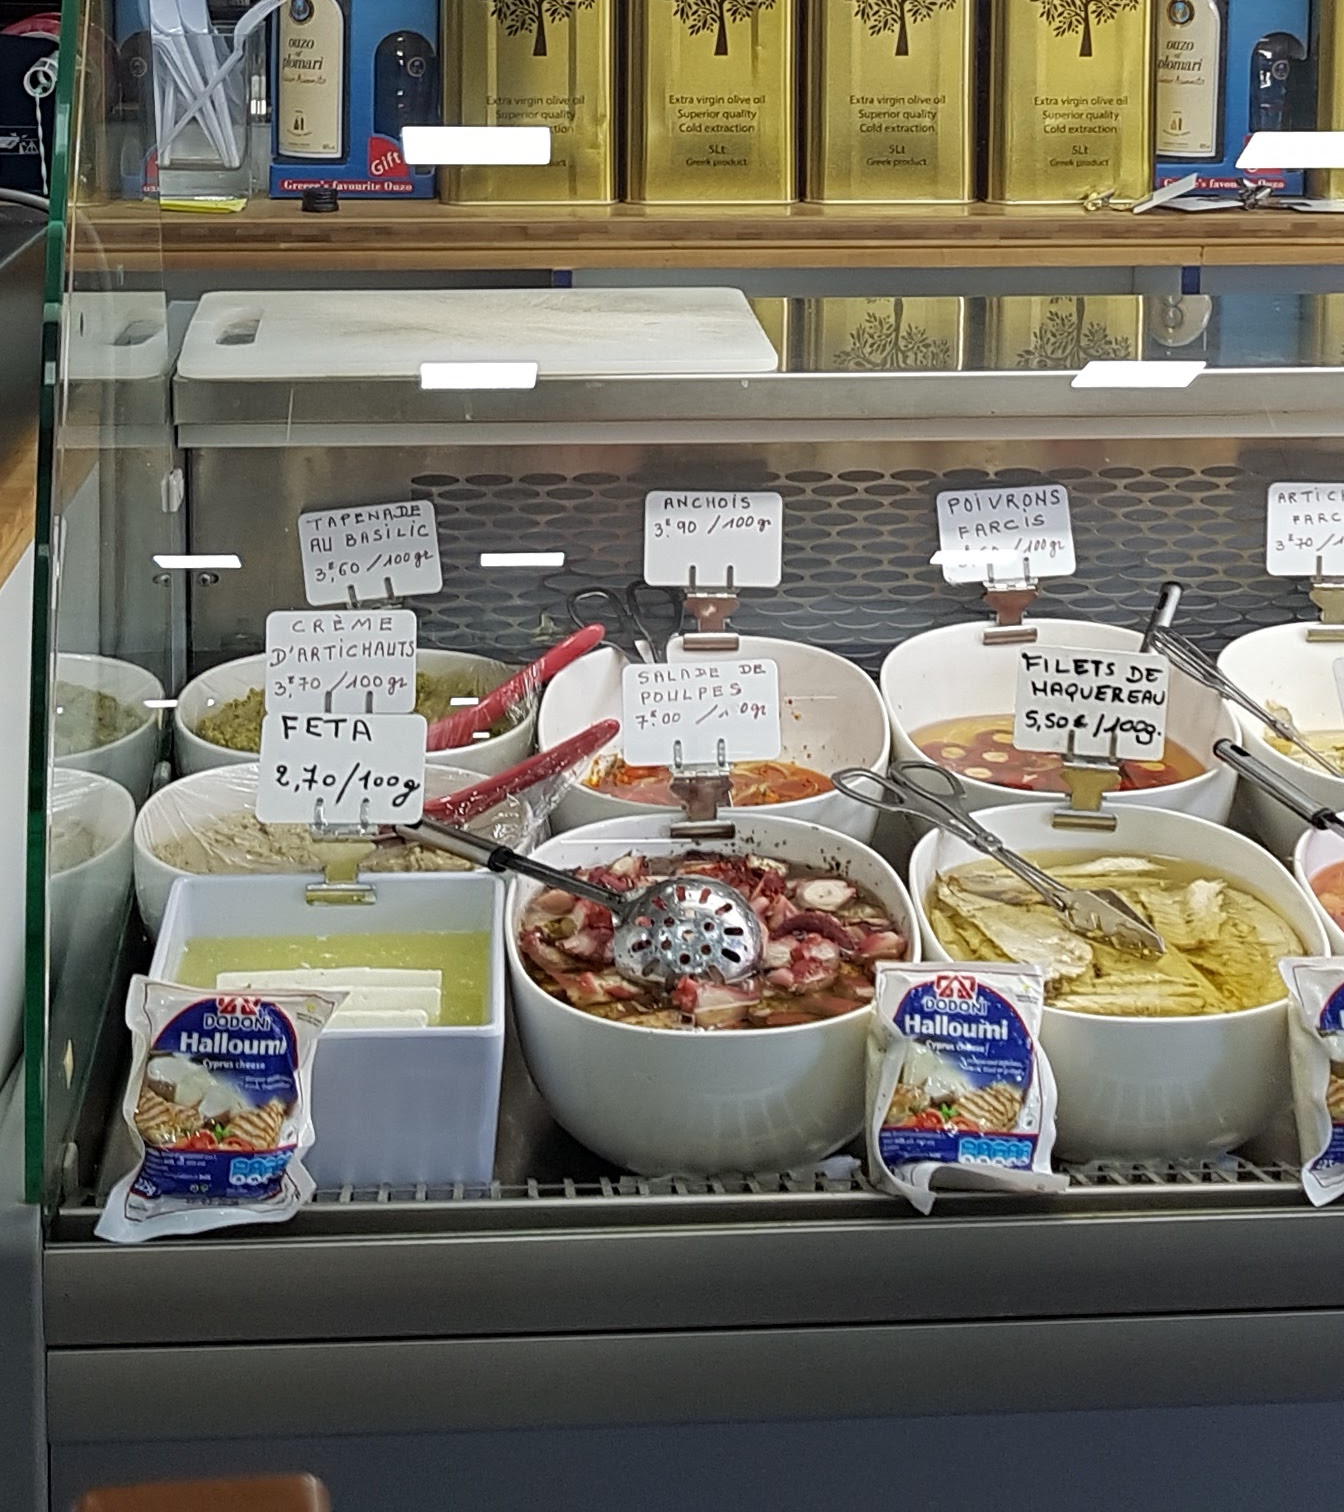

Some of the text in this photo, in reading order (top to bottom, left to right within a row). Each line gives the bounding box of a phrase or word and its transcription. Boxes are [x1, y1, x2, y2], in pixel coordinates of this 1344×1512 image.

[288, 37, 314, 50] ouzo
[1166, 40, 1194, 51] ouzo
[669, 95, 765, 108] Extra virgin olive oil
[849, 95, 946, 108] Extra virgin olive oil
[677, 109, 757, 122] Superior quality
[858, 109, 937, 122] Superior quality
[679, 123, 755, 133] Cold extraction
[860, 123, 935, 133] Cold extraction
[371, 151, 400, 175] Gift
[713, 158, 747, 168] product
[894, 158, 927, 168] product
[384, 181, 412, 191] Ouzo
[664, 494, 751, 510] ANCHOIS
[948, 489, 1060, 515] POIVRONS
[306, 505, 422, 530] TAPENADE
[958, 512, 1045, 539] FARCIS
[310, 521, 429, 553] AU BASILIC
[292, 615, 392, 632] CRÈME
[270, 639, 415, 667] D'ARTICHAUTS
[638, 663, 766, 684] SALADE DE
[1022, 652, 1162, 682] FILETS DE
[641, 683, 742, 705] POULPES
[282, 716, 372, 742] FETA
[923, 997, 988, 1016] DODONI
[203, 1013, 272, 1031] DODONI
[905, 1014, 1008, 1040] Halloumi
[180, 1032, 286, 1055] Halloumi
[203, 1059, 265, 1071] Cyprus cheese
